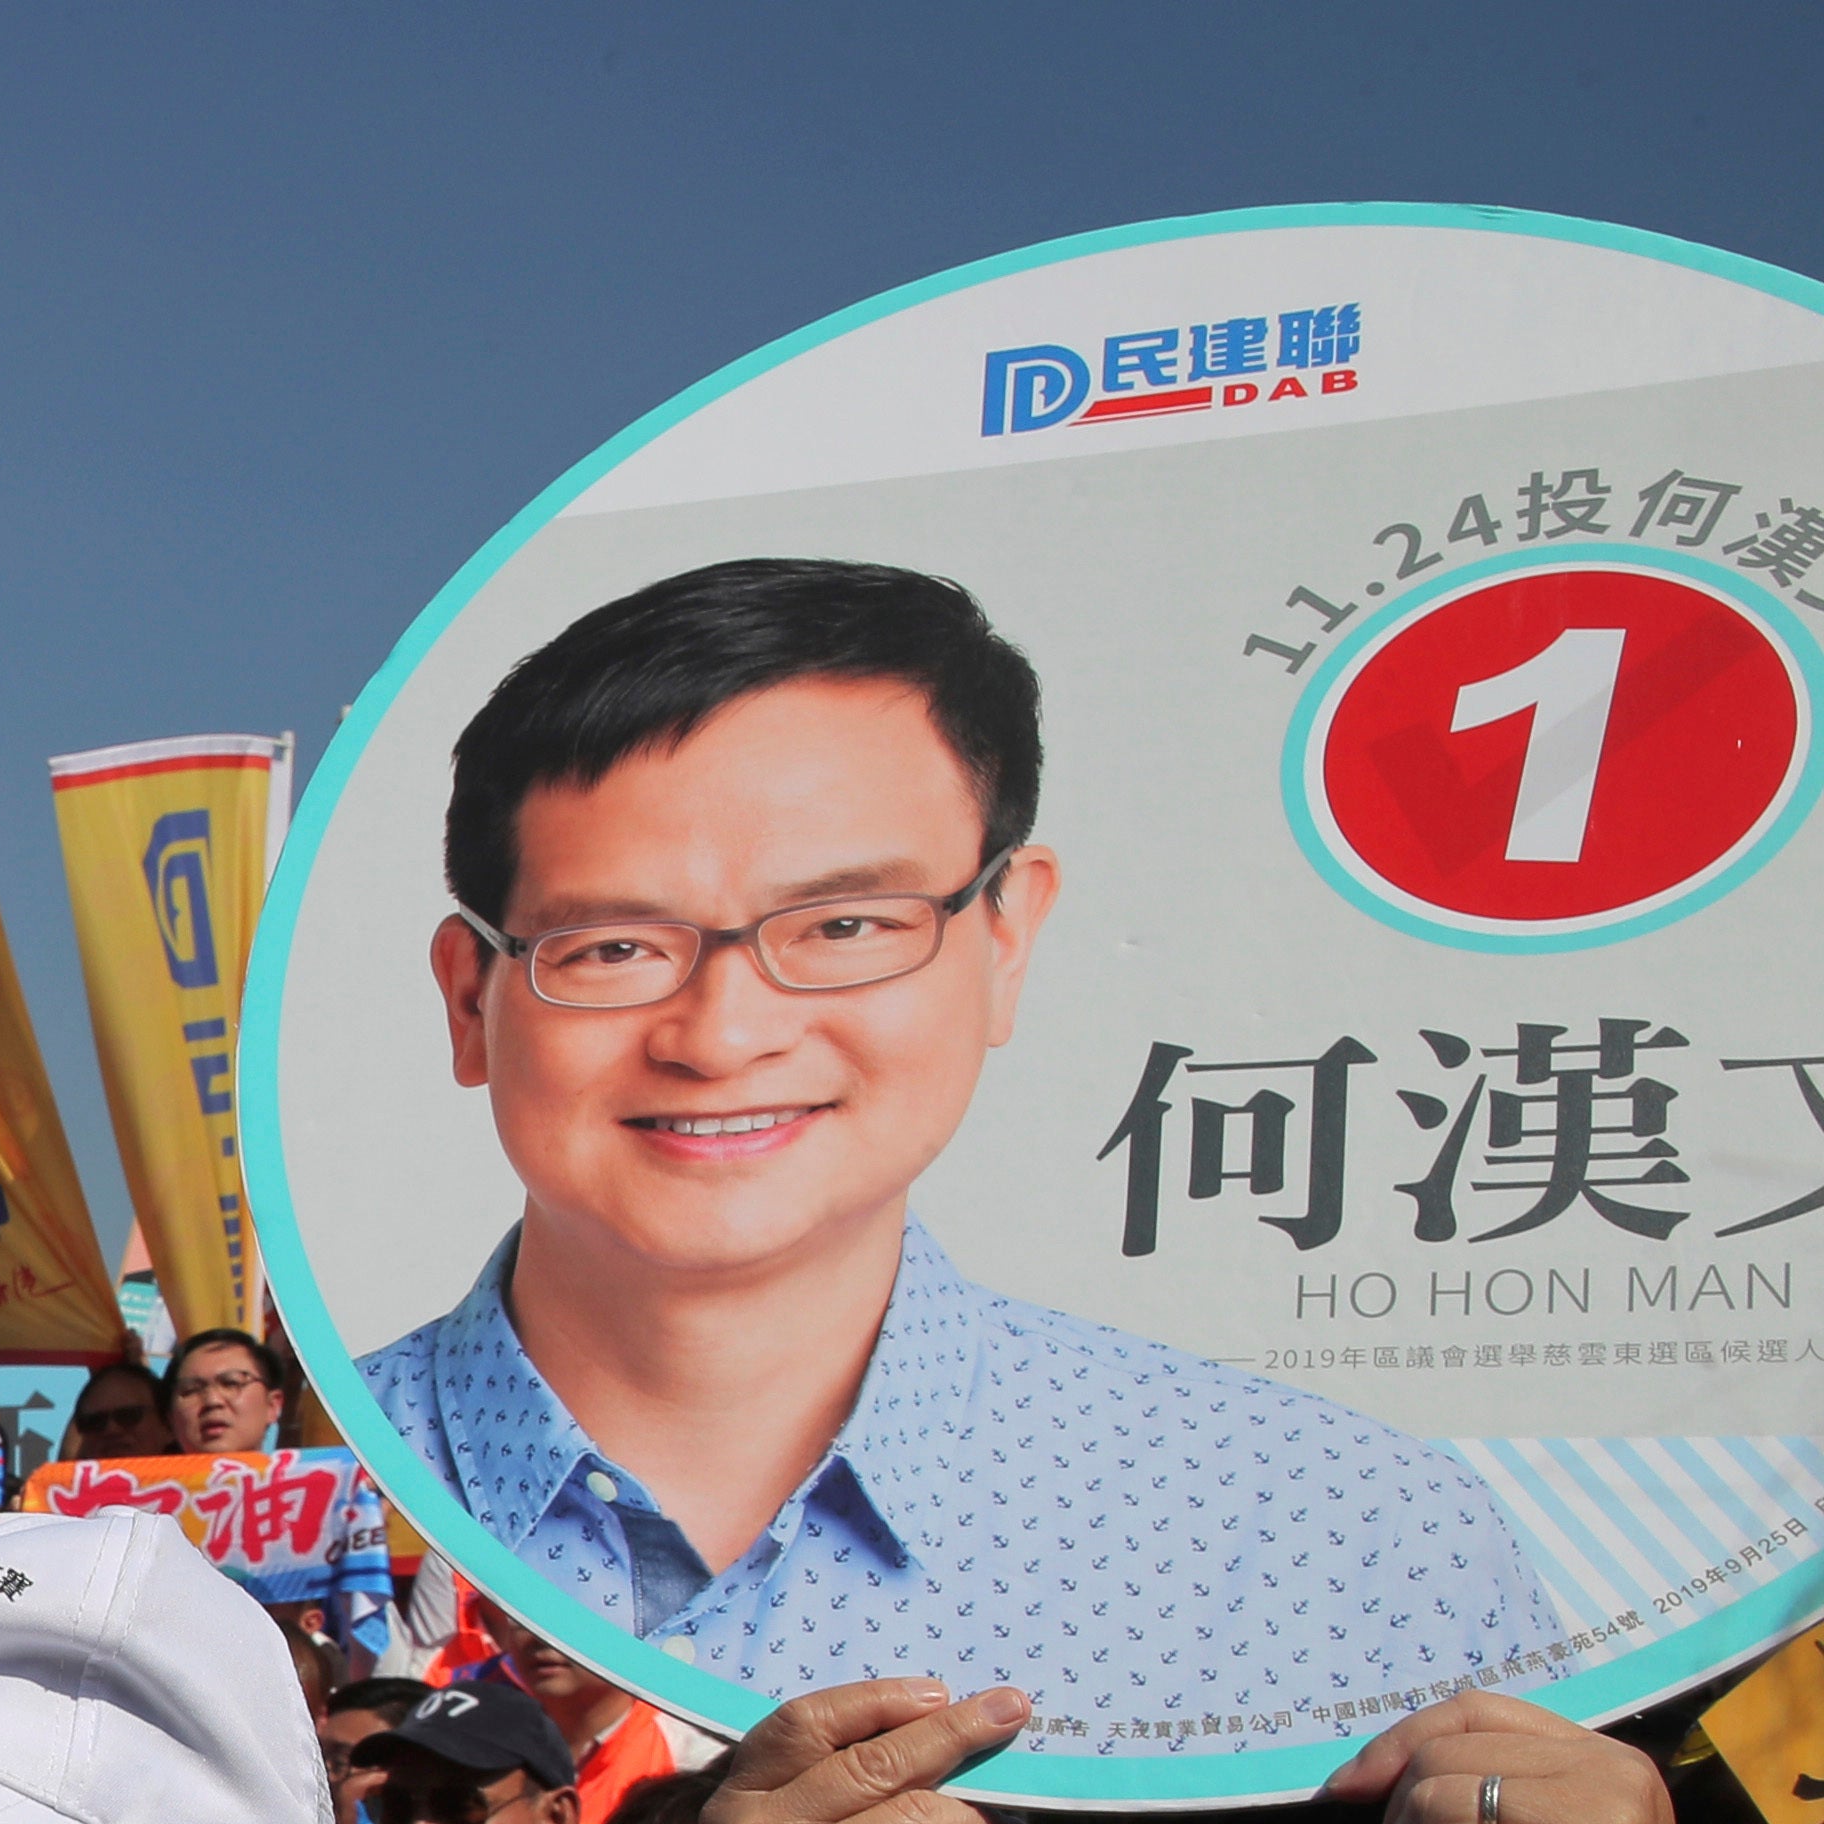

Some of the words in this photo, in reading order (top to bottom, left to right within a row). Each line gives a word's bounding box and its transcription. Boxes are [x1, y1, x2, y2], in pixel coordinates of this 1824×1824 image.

[1101, 303, 1361, 392] 民建聯
[1223, 369, 1359, 407] DAB
[1449, 628, 1627, 863] 1
[1296, 1272, 1398, 1320] HO
[1429, 1268, 1590, 1317] HON
[1627, 1262, 1792, 1313] MAN
